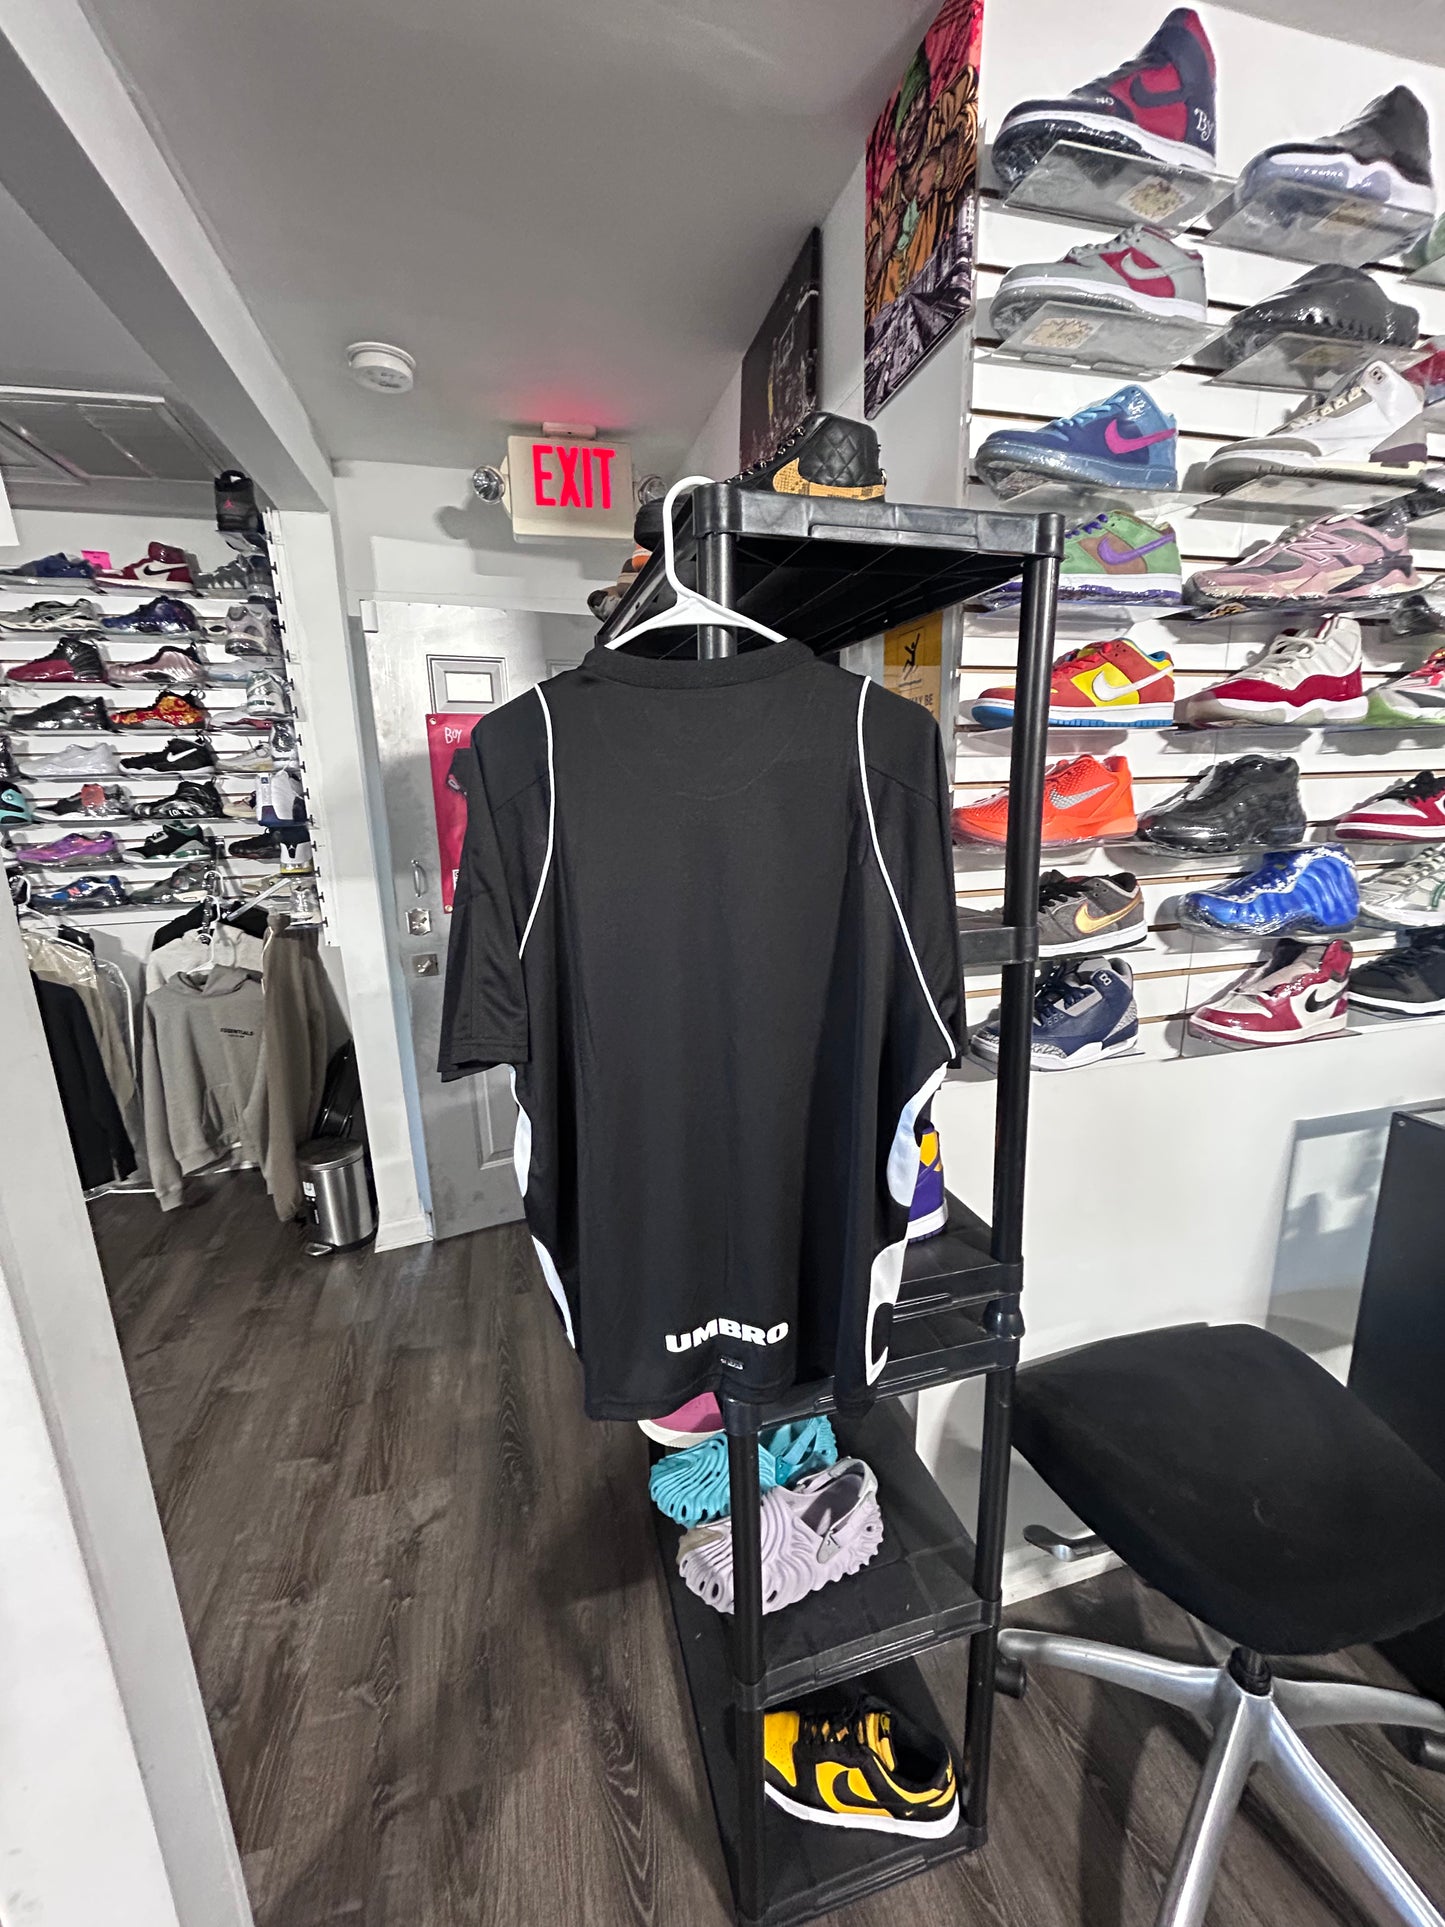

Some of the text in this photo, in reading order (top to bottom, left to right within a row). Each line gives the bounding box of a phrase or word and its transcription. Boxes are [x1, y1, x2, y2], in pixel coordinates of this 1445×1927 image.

[532, 443, 616, 510] EXIT
[924, 692, 933, 706] BE
[664, 1317, 789, 1353] UMBRO
